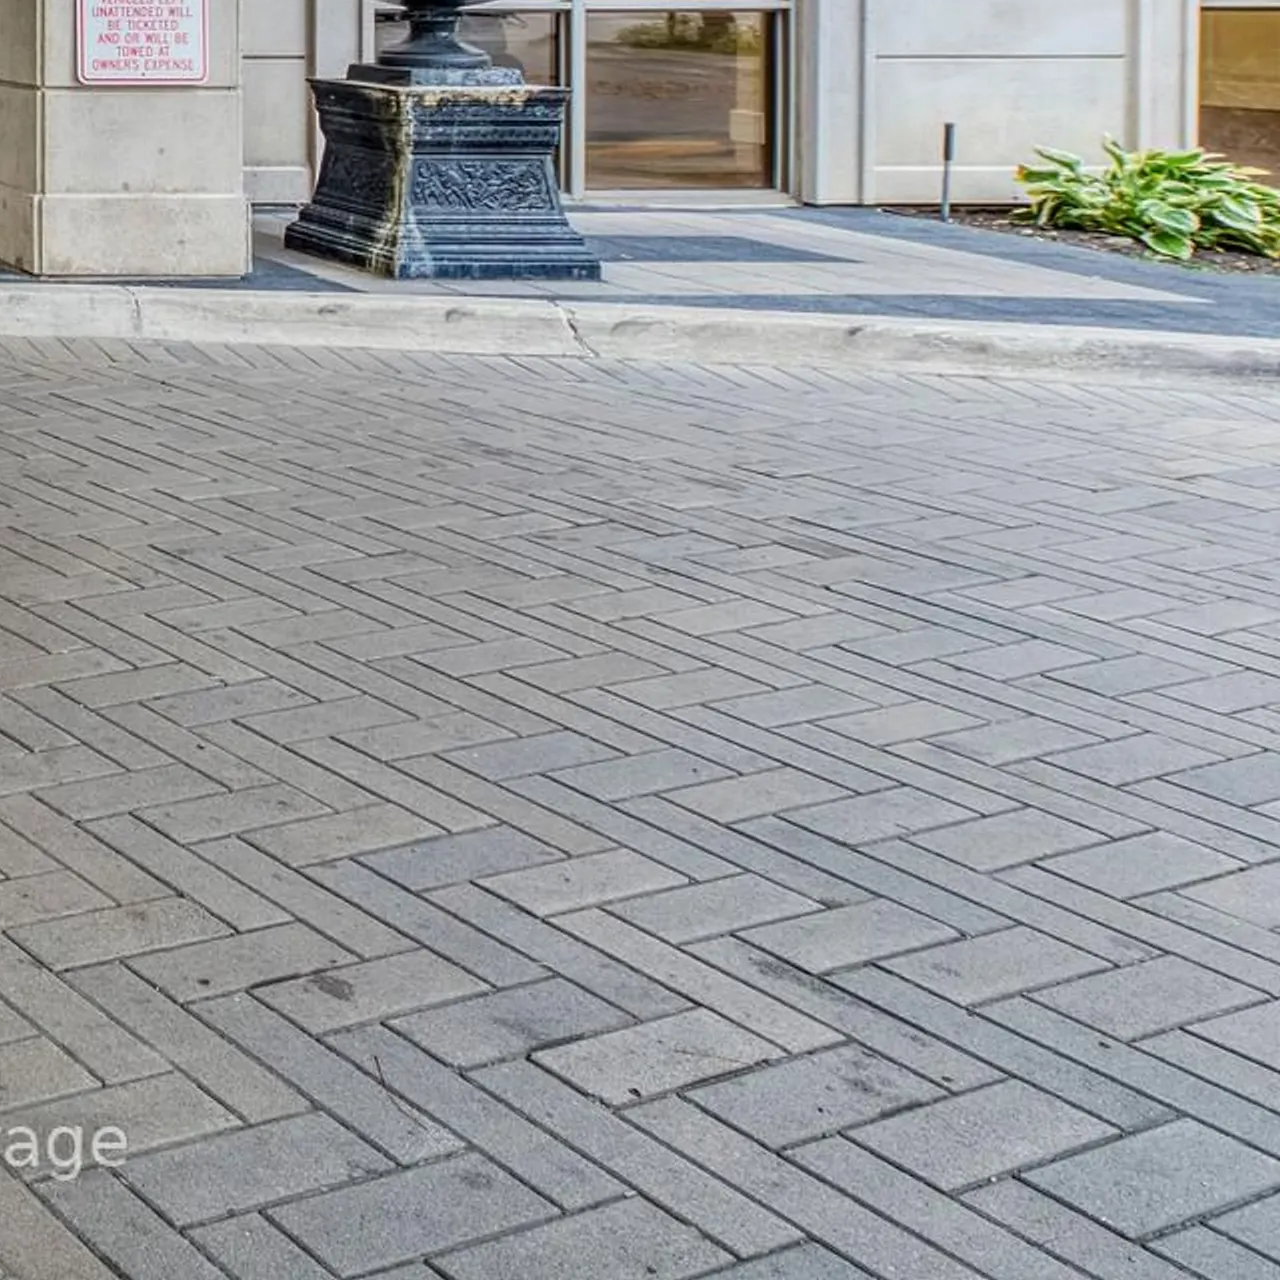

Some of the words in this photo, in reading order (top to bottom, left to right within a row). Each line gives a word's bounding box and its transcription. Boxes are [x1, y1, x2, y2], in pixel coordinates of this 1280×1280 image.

[92, 6, 163, 18] UNATTENDED
[168, 6, 193, 18] WILL
[107, 20, 123, 31] BE
[128, 20, 178, 31] TICKETED
[97, 33, 120, 44] AND
[124, 33, 140, 44] OR
[145, 33, 170, 44] WILL
[174, 33, 189, 44] BE
[116, 46, 153, 57] TOWED
[157, 46, 170, 57] AT
[144, 60, 194, 71] EXPENSE
